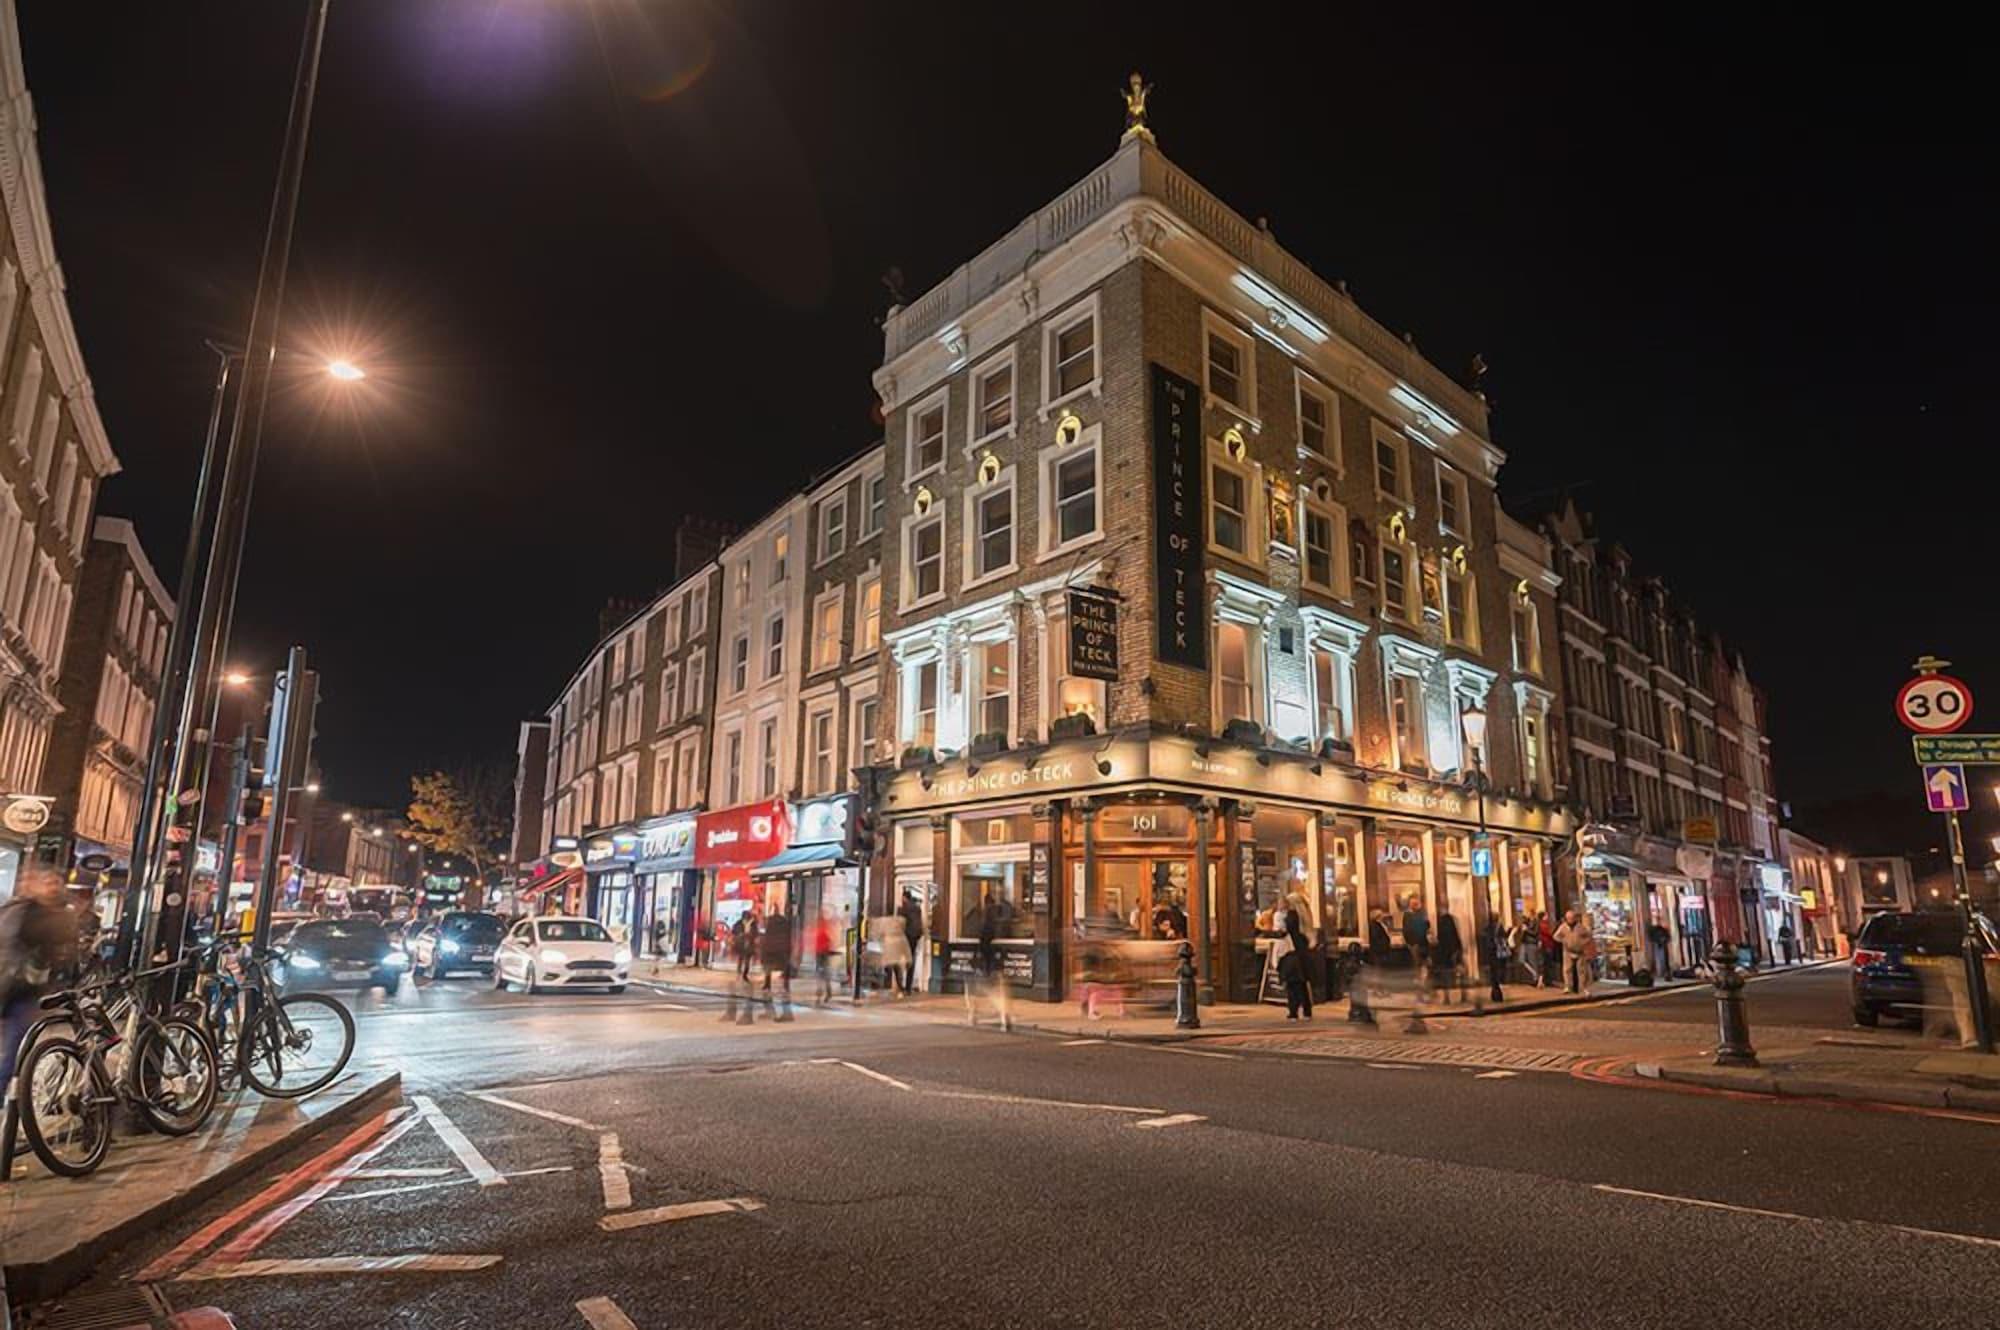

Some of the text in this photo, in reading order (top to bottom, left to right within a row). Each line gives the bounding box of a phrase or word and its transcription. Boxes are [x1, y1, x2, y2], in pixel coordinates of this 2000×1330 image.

[1169, 402, 1184, 518] PRINCE
[1168, 532, 1188, 551] OF
[1080, 601, 1107, 619] THE
[1174, 569, 1187, 649] TECK
[1072, 615, 1117, 636] PRINCE
[1086, 631, 1103, 646] OF
[1078, 645, 1112, 663] TECK
[1907, 690, 1961, 718] 30
[932, 763, 1073, 793] THE PRINCE OF TECK
[1133, 814, 1157, 831] 161
